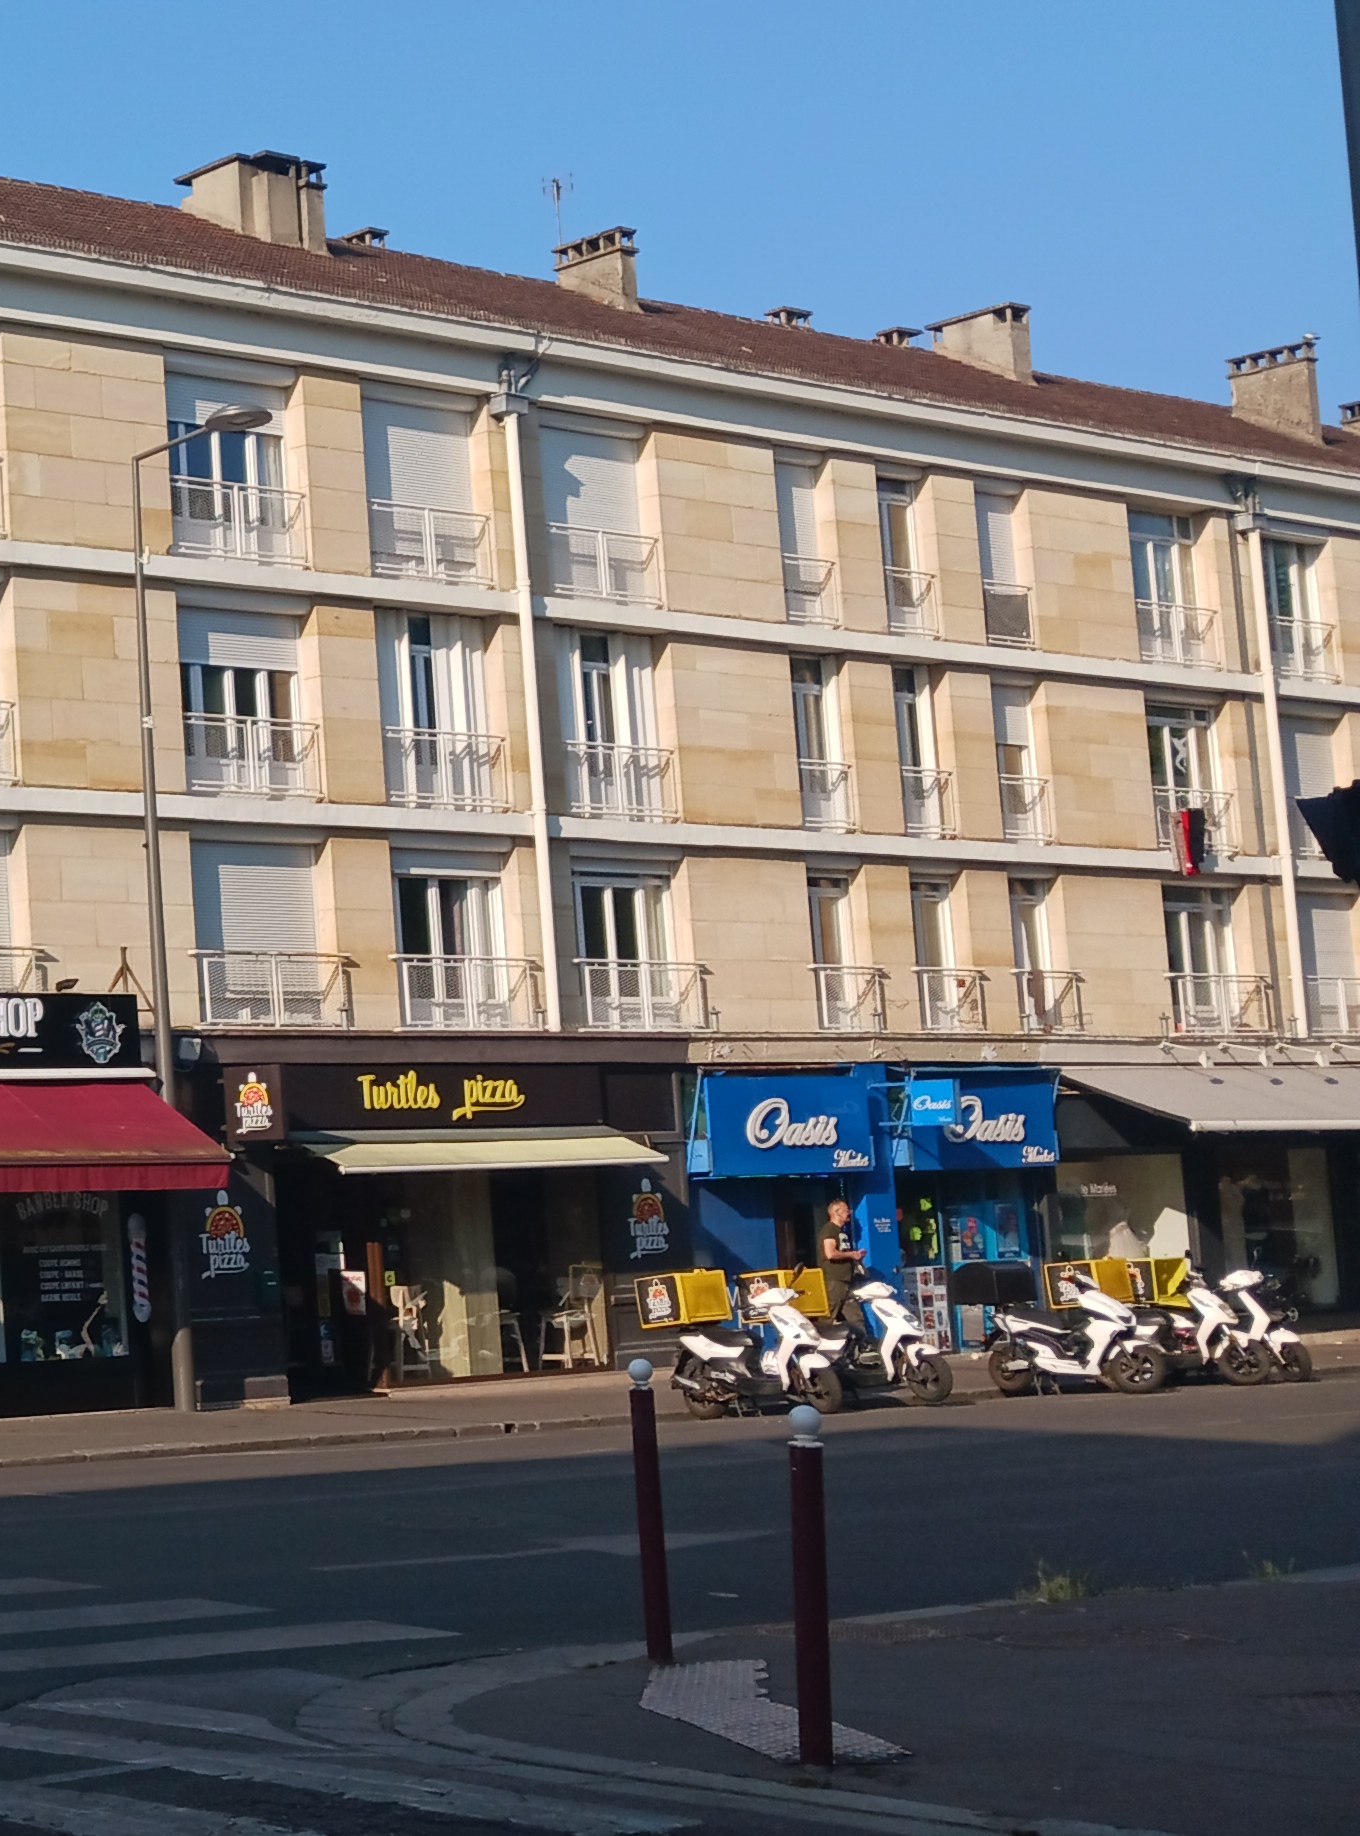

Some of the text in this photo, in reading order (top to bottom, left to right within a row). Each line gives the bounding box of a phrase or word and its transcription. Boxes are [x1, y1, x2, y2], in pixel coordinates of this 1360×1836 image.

[356, 1069, 526, 1121] Turtles pizza
[912, 1095, 953, 1111] Oasis
[234, 1101, 273, 1117] Turtles
[944, 1095, 1026, 1143] Oasis
[236, 1115, 273, 1134] pizza
[745, 1097, 838, 1149] Oasis
[16, 1190, 109, 1220] BARBER SHOP
[627, 1215, 670, 1237] Turtles
[198, 1230, 251, 1255] Turtles
[630, 1235, 669, 1259] pizza
[201, 1251, 250, 1280] pizza
